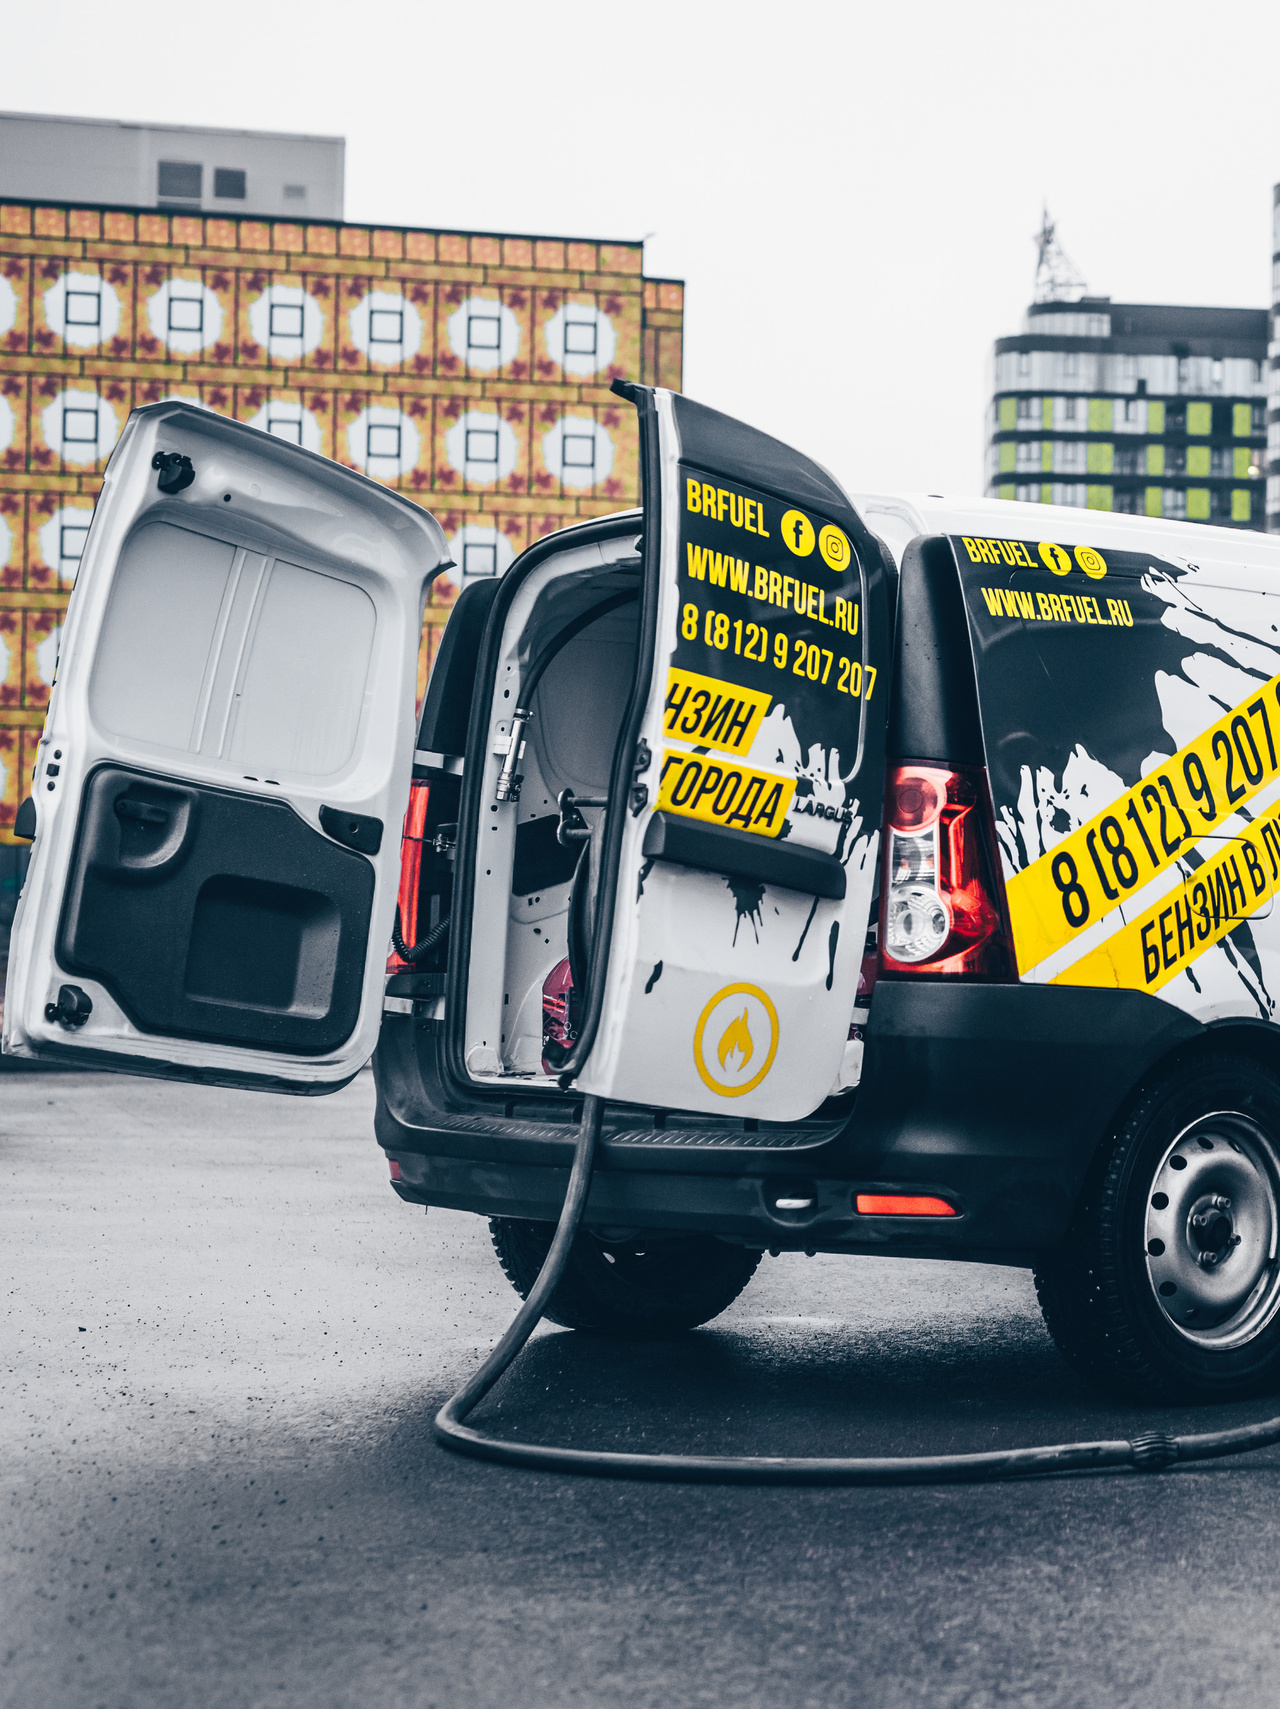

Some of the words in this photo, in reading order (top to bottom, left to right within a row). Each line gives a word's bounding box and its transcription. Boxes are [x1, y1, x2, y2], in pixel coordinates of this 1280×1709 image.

[686, 478, 770, 538] BRFUEL
[686, 542, 859, 636] WWW.BRFUEL.RU
[961, 536, 1039, 568] BRFUEL
[980, 587, 1134, 628] WWW.BRFUEL.RU
[681, 603, 699, 641] 8
[704, 609, 769, 663] (812)
[773, 632, 789, 669] 9
[792, 639, 834, 685] 207
[837, 656, 878, 701] 207
[659, 755, 785, 829] ГОРОДА
[792, 796, 854, 826] LARGUS
[1051, 851, 1090, 928] 8
[1086, 774, 1193, 901] (812)
[1182, 752, 1217, 822] 9
[1211, 697, 1278, 805] 207
[1140, 854, 1247, 985] БЕНЗИН
[1240, 840, 1266, 898] В
